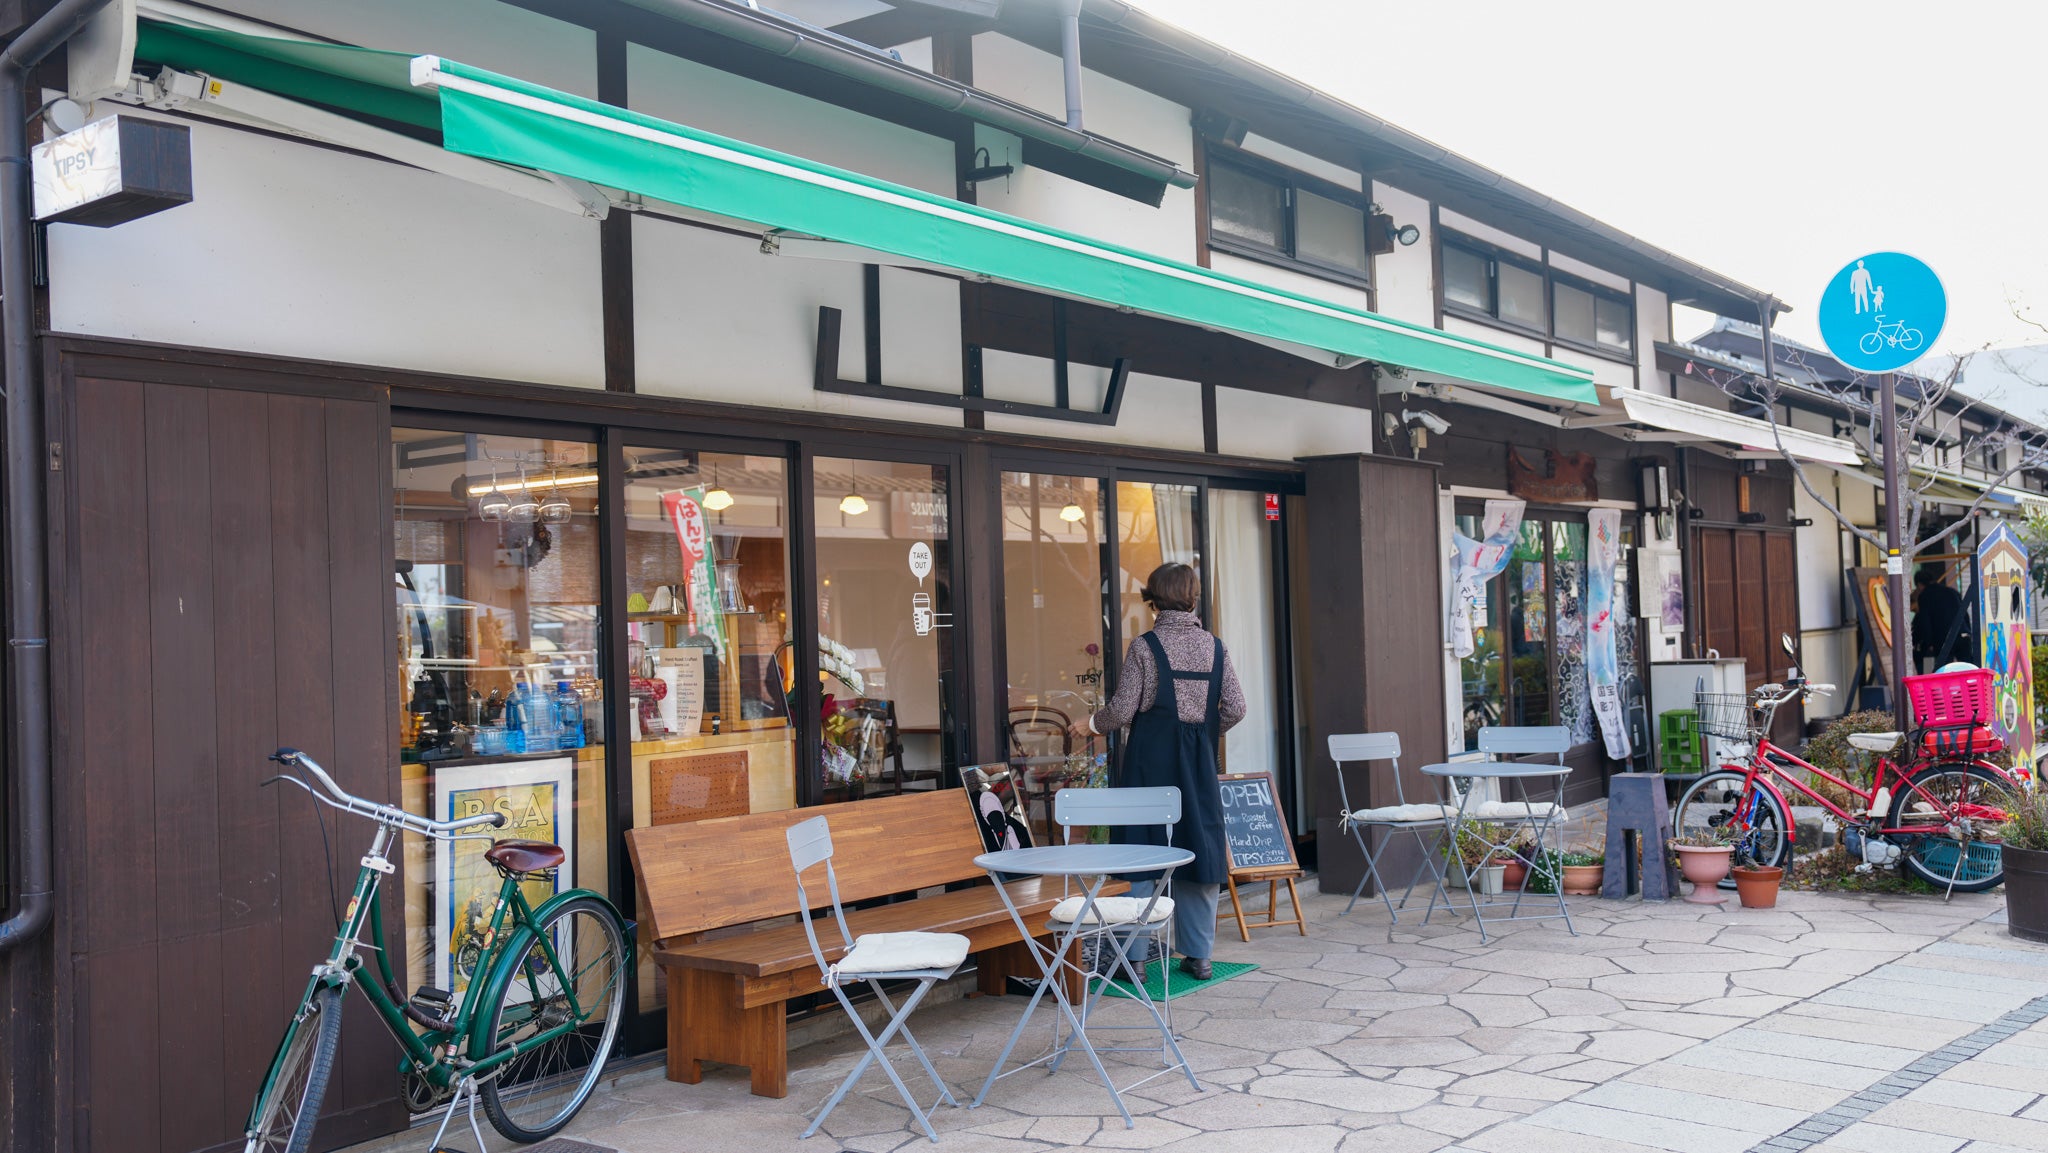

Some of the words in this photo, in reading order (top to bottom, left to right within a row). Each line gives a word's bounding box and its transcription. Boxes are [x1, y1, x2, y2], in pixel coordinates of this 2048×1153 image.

[54, 147, 96, 178] TIPSY
[678, 501, 705, 563] はんこ
[913, 552, 928, 560] TAKE
[914, 561, 927, 569] OUT
[1075, 673, 1102, 684] TIPSY
[1220, 782, 1272, 808] OPEN
[1241, 811, 1267, 823] Roasted
[1249, 821, 1273, 831] Coffee
[1229, 833, 1252, 847] Hand
[1252, 834, 1272, 847] Drip
[1234, 852, 1264, 865] TIPSY
